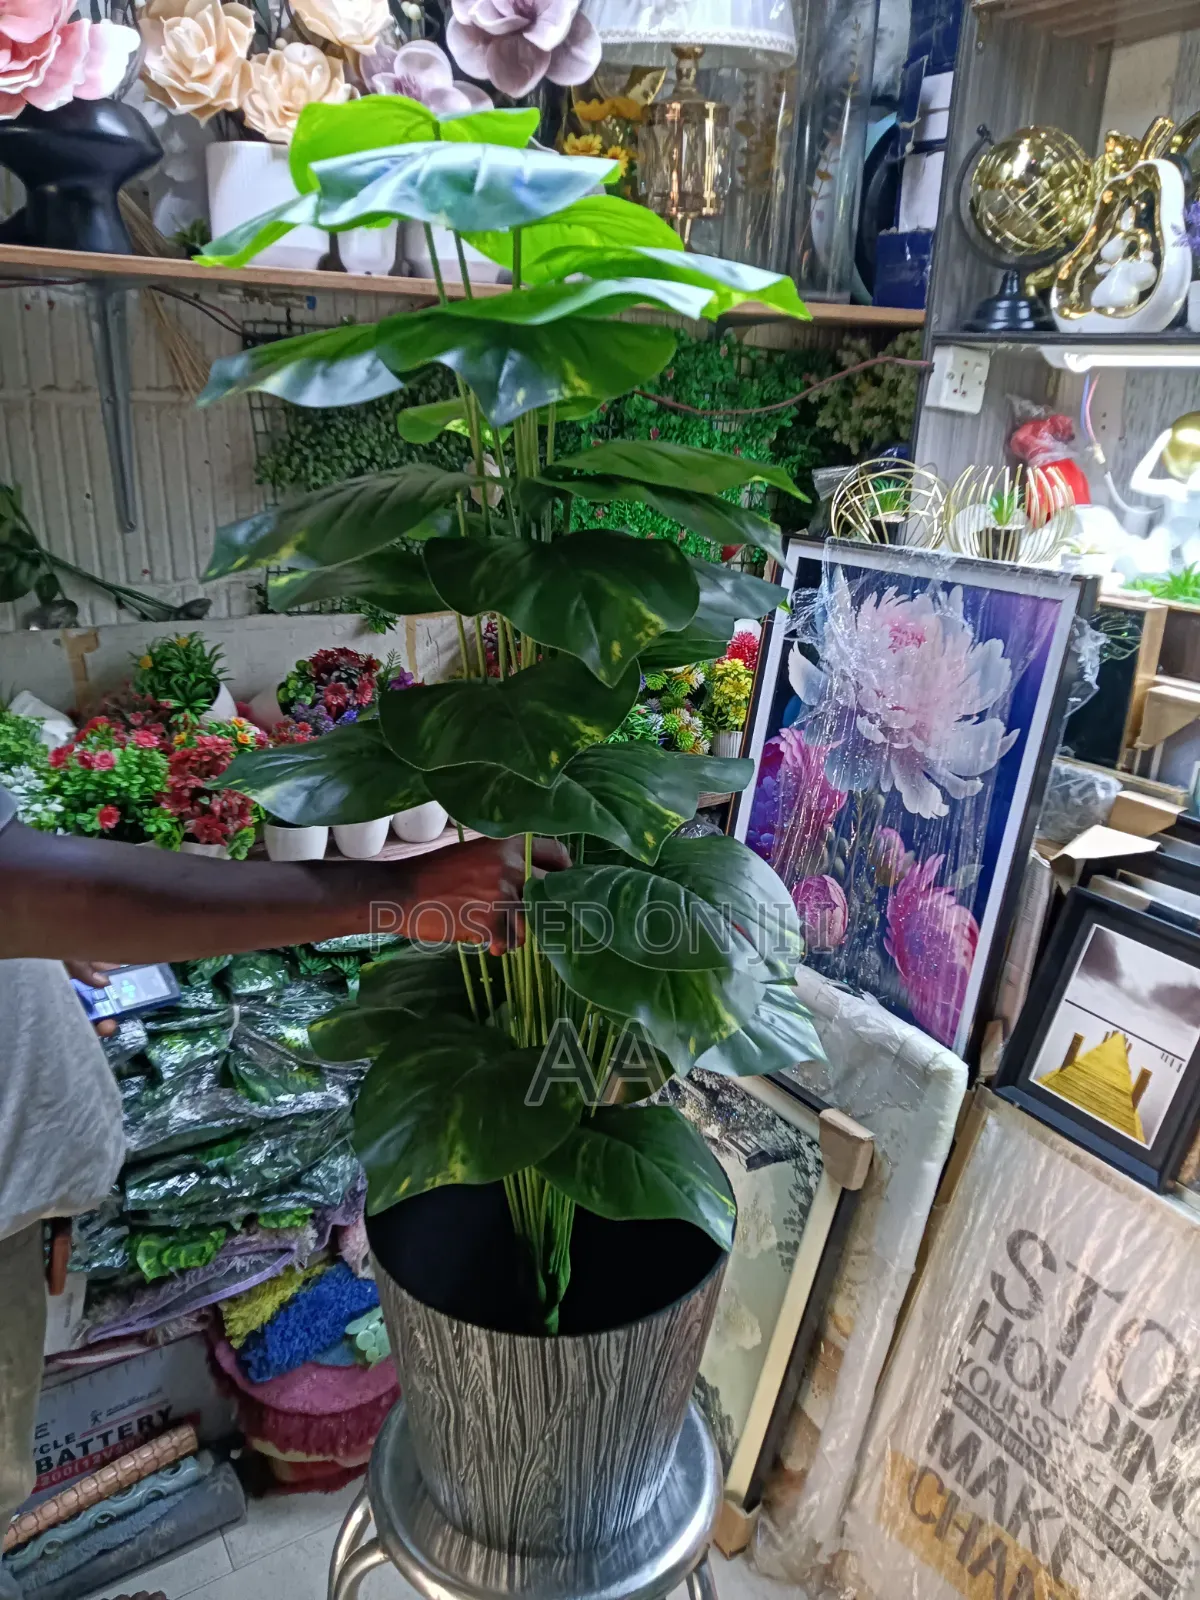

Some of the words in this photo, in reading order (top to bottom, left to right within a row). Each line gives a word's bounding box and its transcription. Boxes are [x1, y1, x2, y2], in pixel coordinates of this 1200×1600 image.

[33, 1432, 76, 1456] CLE
[35, 1404, 174, 1475] BATTERY
[926, 1407, 1108, 1592] MAKE
